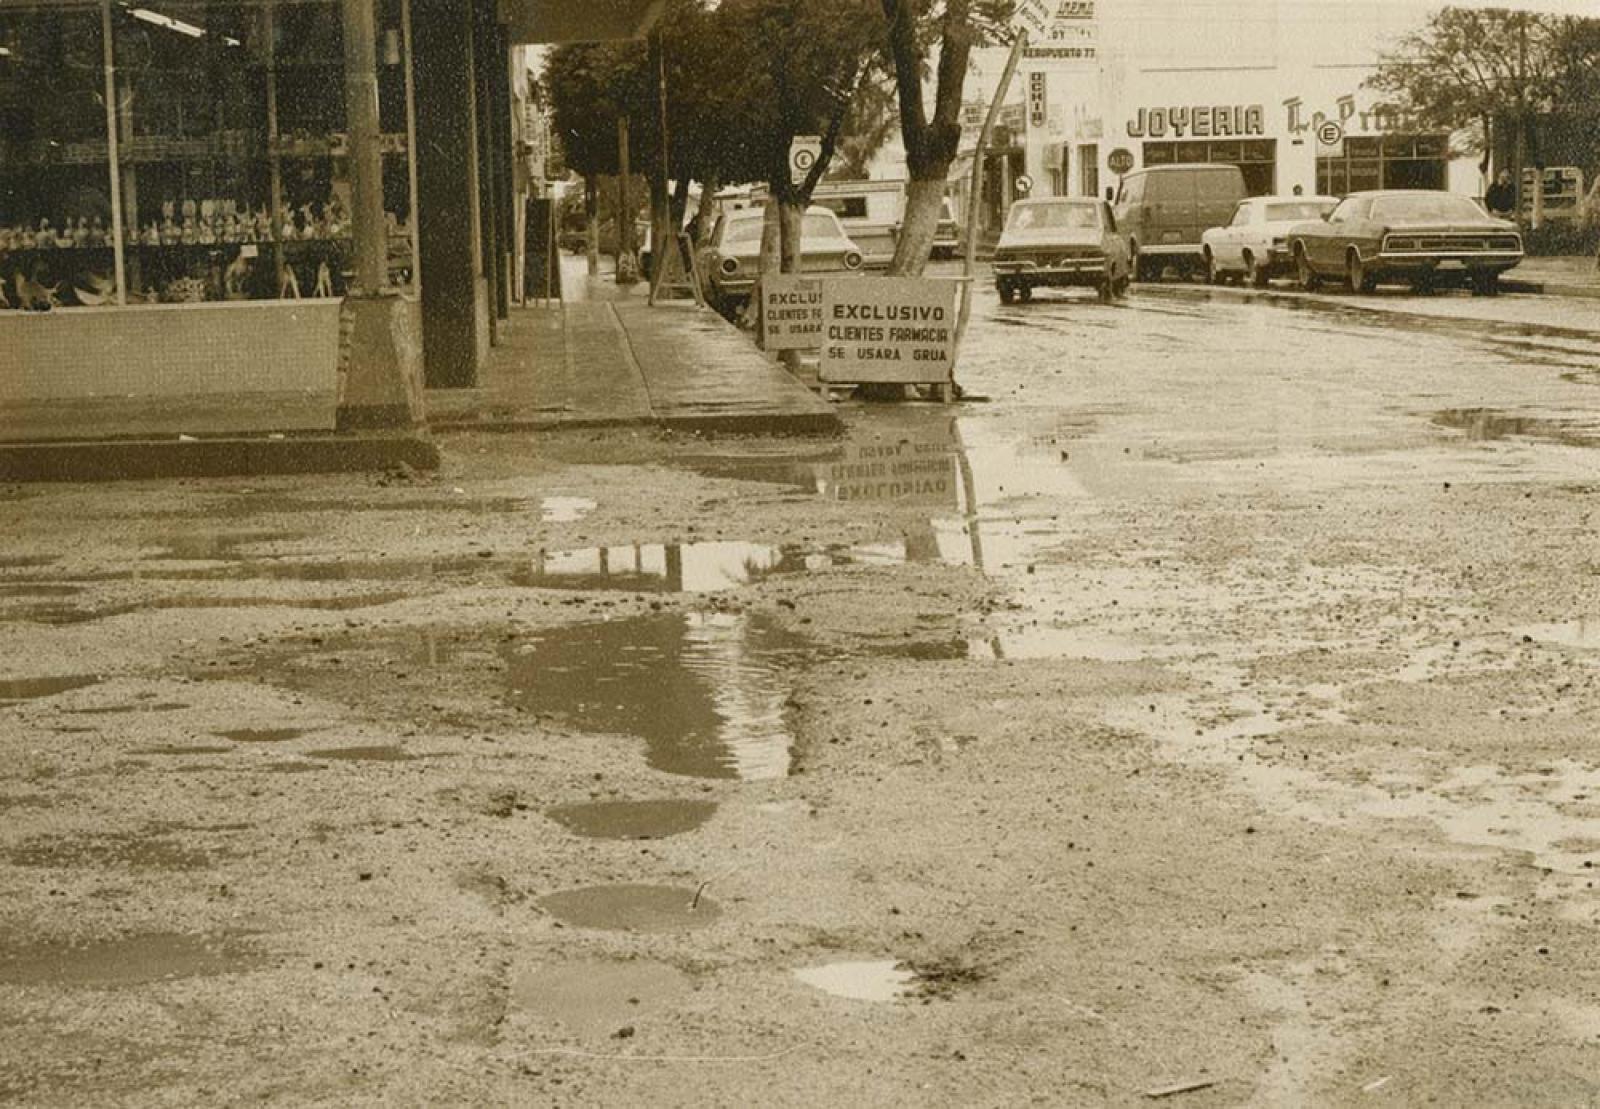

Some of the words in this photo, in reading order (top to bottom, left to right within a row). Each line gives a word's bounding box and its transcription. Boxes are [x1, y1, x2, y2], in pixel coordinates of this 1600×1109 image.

[1126, 104, 1265, 138] JOYERIA
[1110, 155, 1132, 168] ALTO
[833, 304, 945, 321] EXCLUSIVO
[828, 325, 884, 342] CLIENTES
[889, 326, 949, 343] FARMACIA
[828, 347, 846, 359] SE
[857, 349, 902, 361] USARA
[912, 349, 948, 361] GRUA
